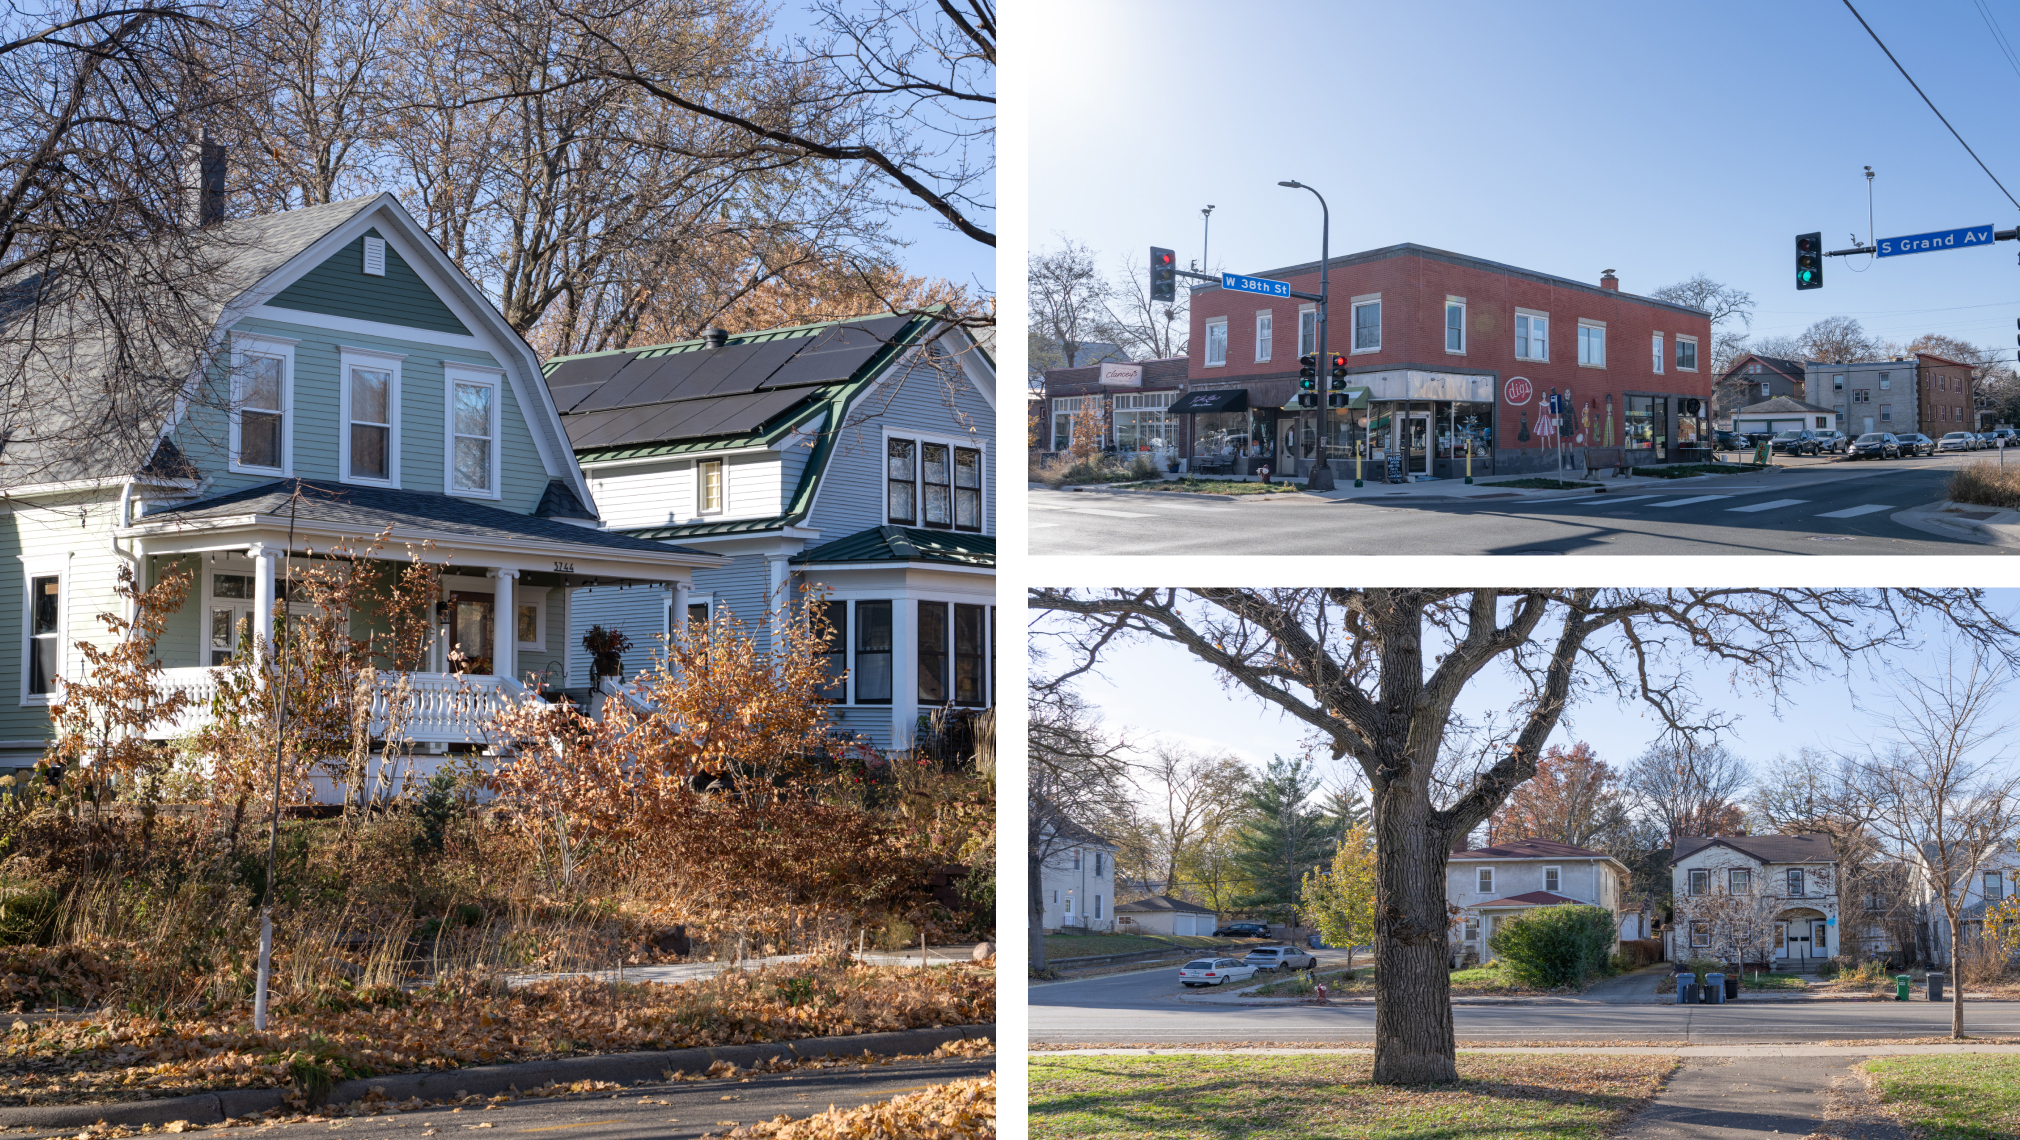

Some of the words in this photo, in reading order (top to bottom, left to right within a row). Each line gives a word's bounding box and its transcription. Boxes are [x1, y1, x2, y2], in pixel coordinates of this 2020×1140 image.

[1881, 242, 1892, 253] S
[1900, 233, 1954, 251] Grand
[1963, 231, 1988, 244] Av
[1225, 276, 1236, 287] W
[1241, 279, 1270, 292] 38th
[1274, 284, 1287, 295] St
[1509, 382, 1531, 399] digs
[553, 561, 575, 572] 3744
